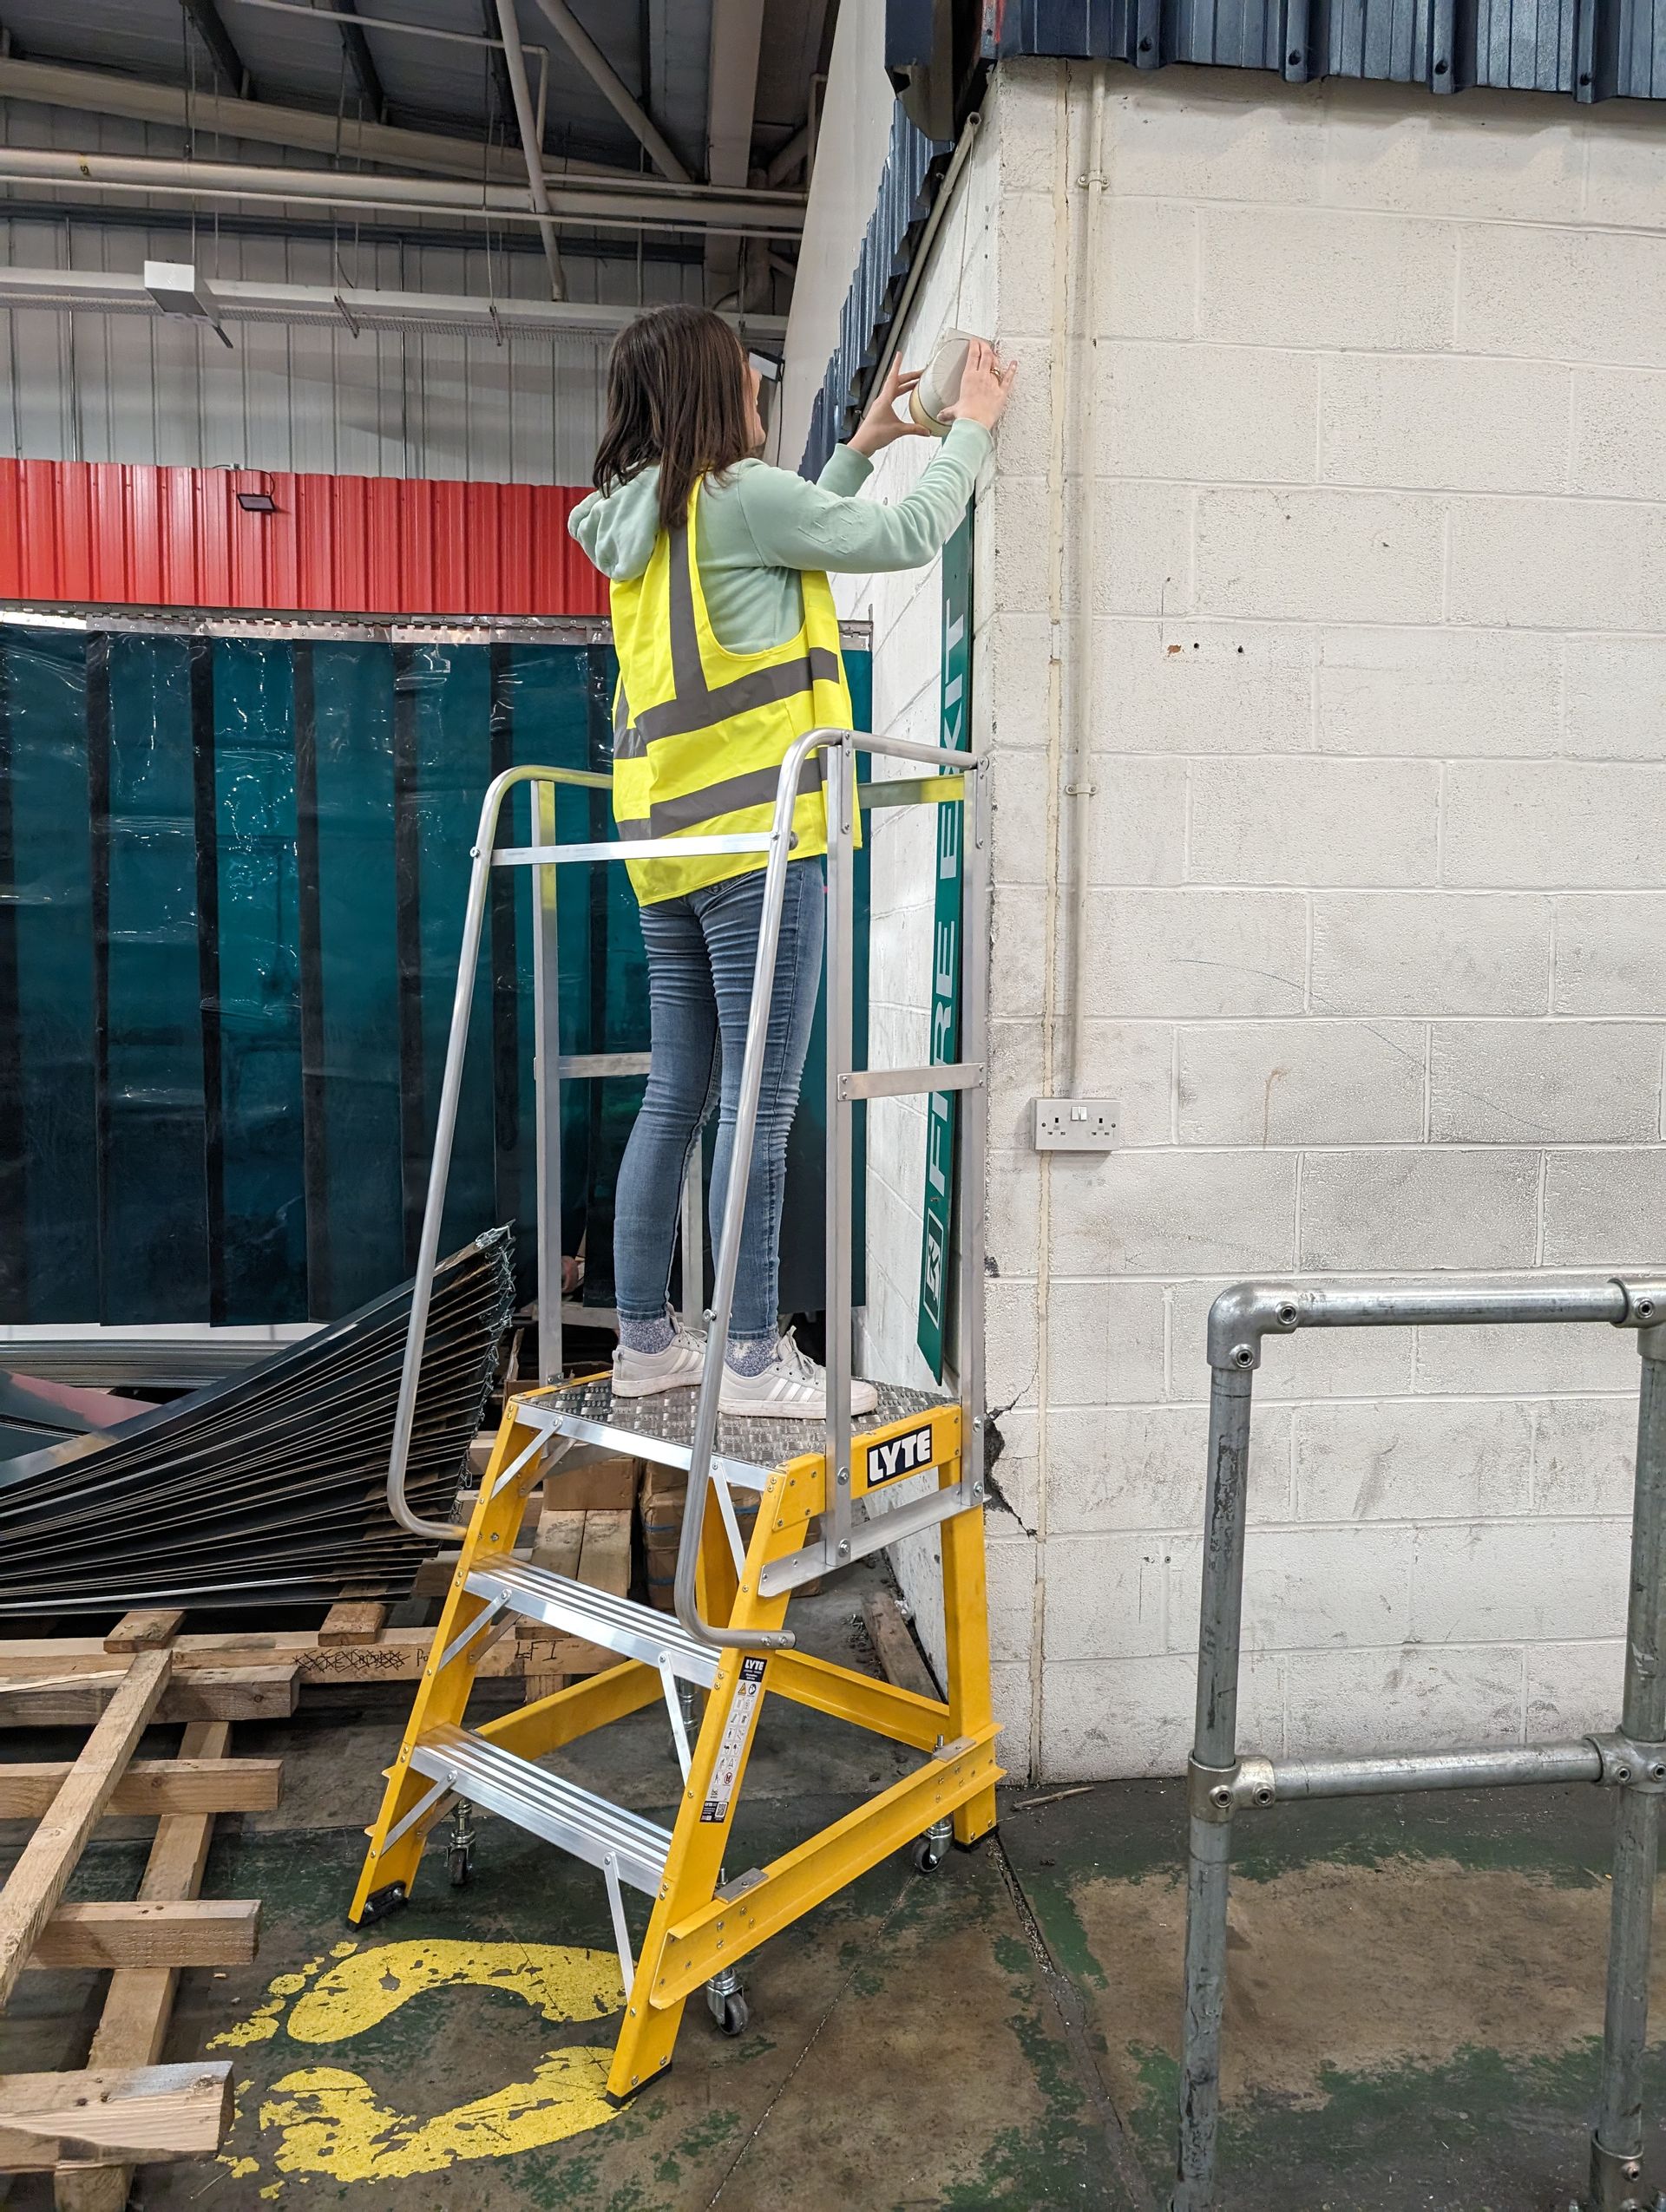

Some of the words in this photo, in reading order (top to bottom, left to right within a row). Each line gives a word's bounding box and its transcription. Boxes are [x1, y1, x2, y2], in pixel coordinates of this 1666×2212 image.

[940, 598, 964, 879] EXIT
[929, 921, 955, 1197] FIRE
[869, 1429, 930, 1482] LYTE
[744, 1659, 764, 1671] LYTE
